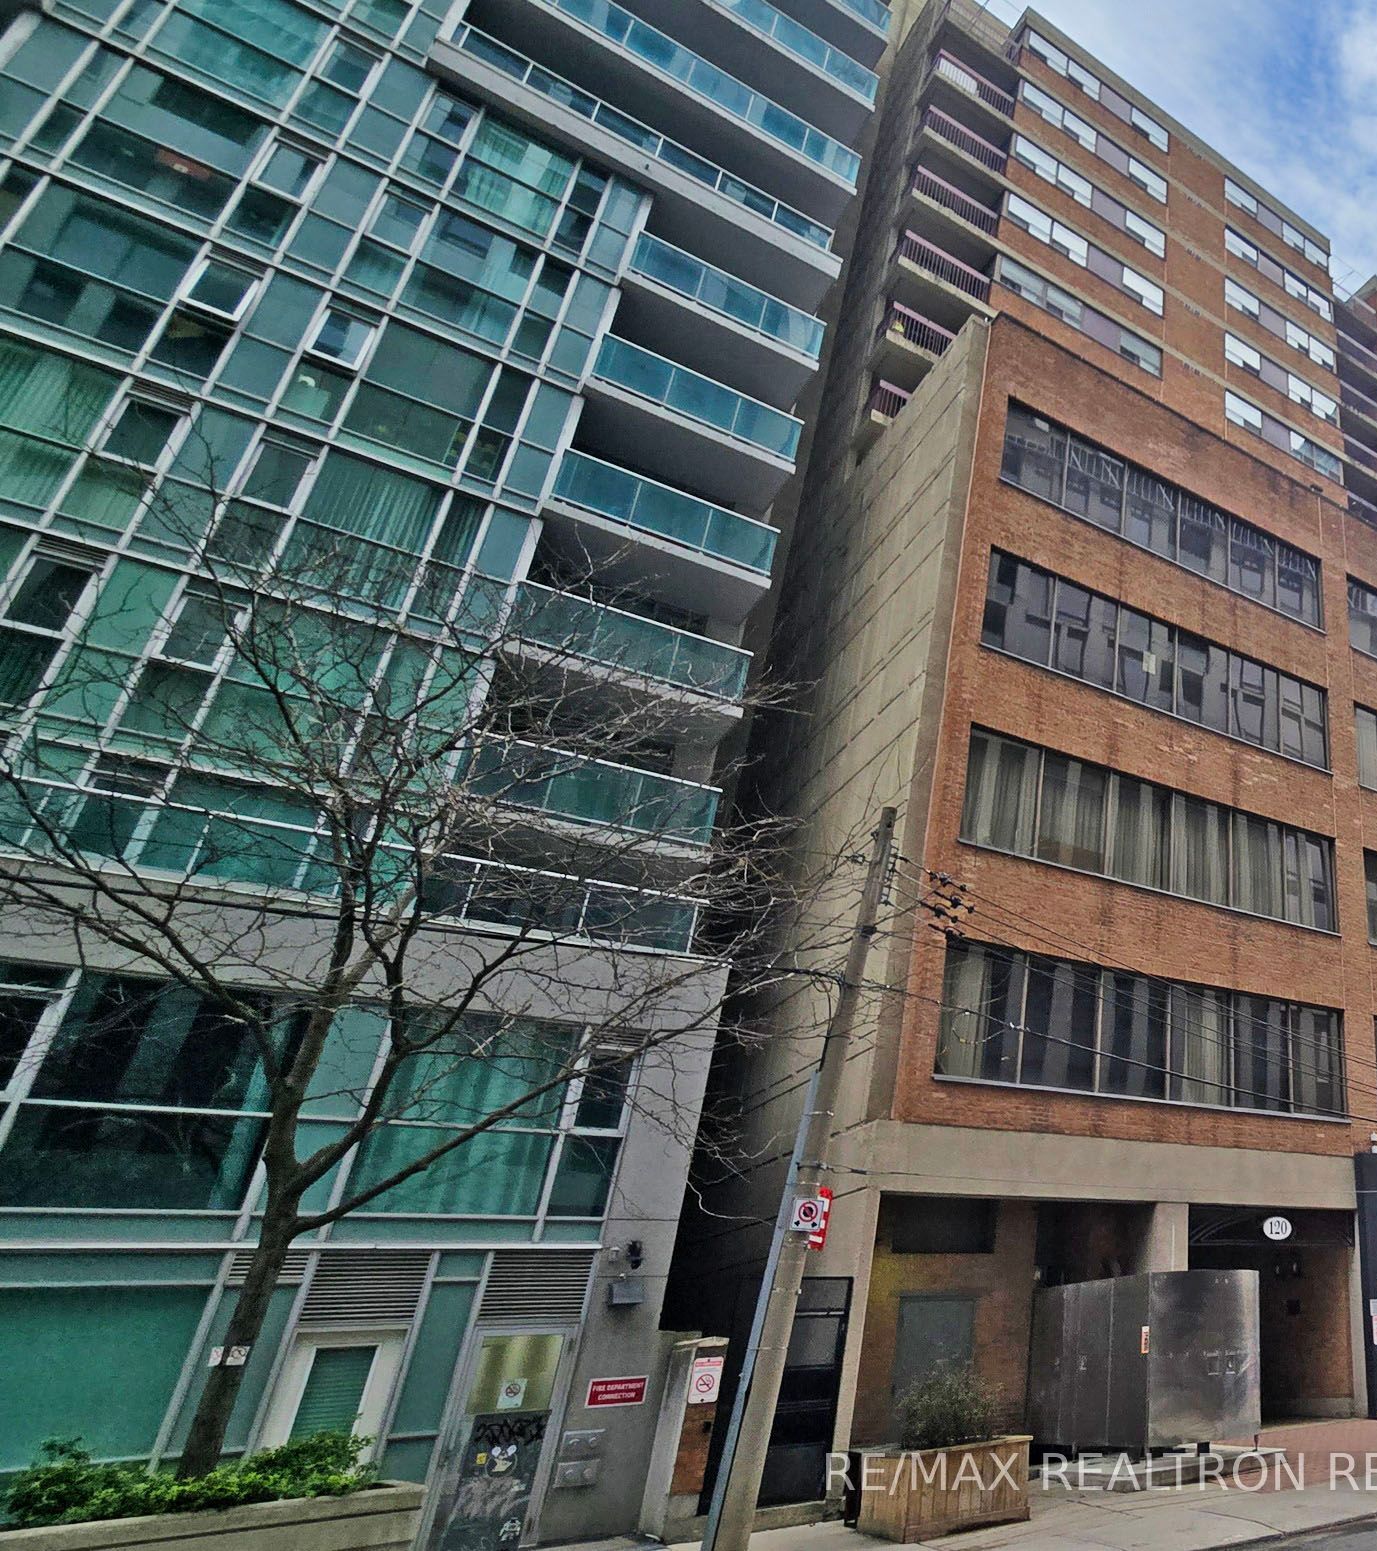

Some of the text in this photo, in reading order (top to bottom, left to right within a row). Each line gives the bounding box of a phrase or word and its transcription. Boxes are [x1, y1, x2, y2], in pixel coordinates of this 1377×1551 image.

[1269, 1220, 1288, 1235] 120
[606, 1382, 644, 1391] DEPARTMENT
[597, 1392, 636, 1401] CONNECTION
